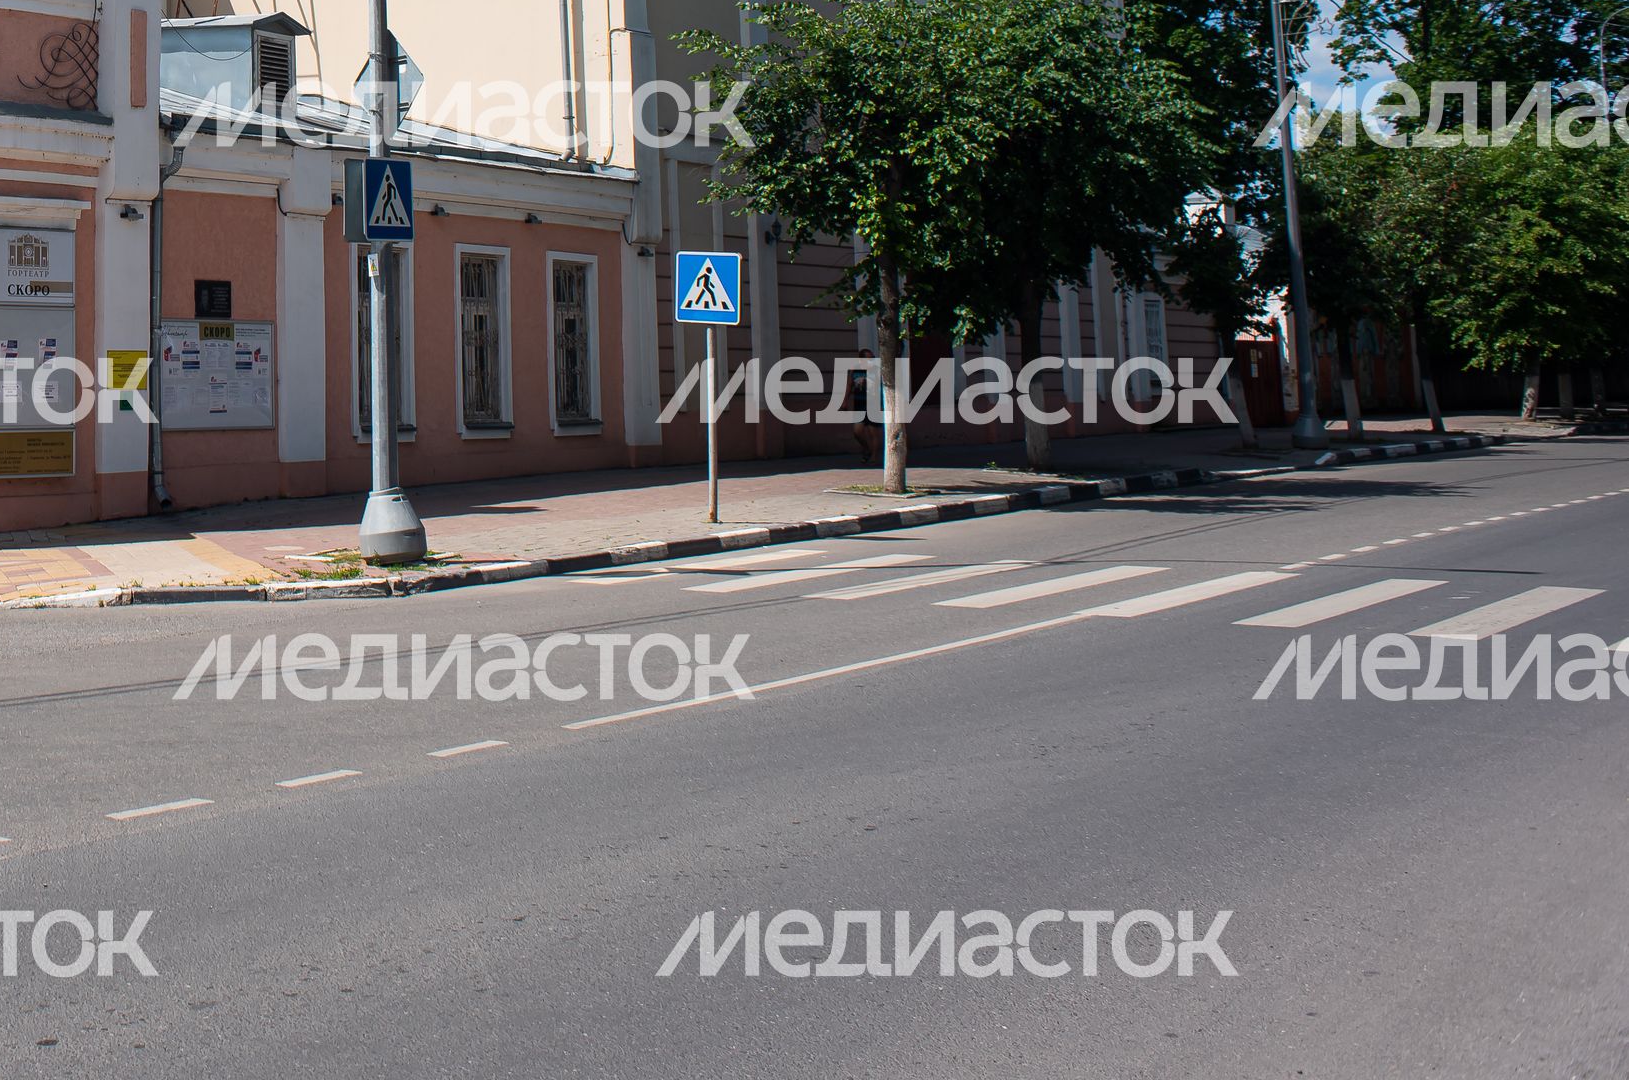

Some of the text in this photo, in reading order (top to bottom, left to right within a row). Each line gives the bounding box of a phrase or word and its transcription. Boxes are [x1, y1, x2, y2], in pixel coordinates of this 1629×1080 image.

[7, 269, 50, 278] ГОРТЕАТР
[7, 284, 50, 296] СКОРО
[203, 326, 231, 338] СКОРО
